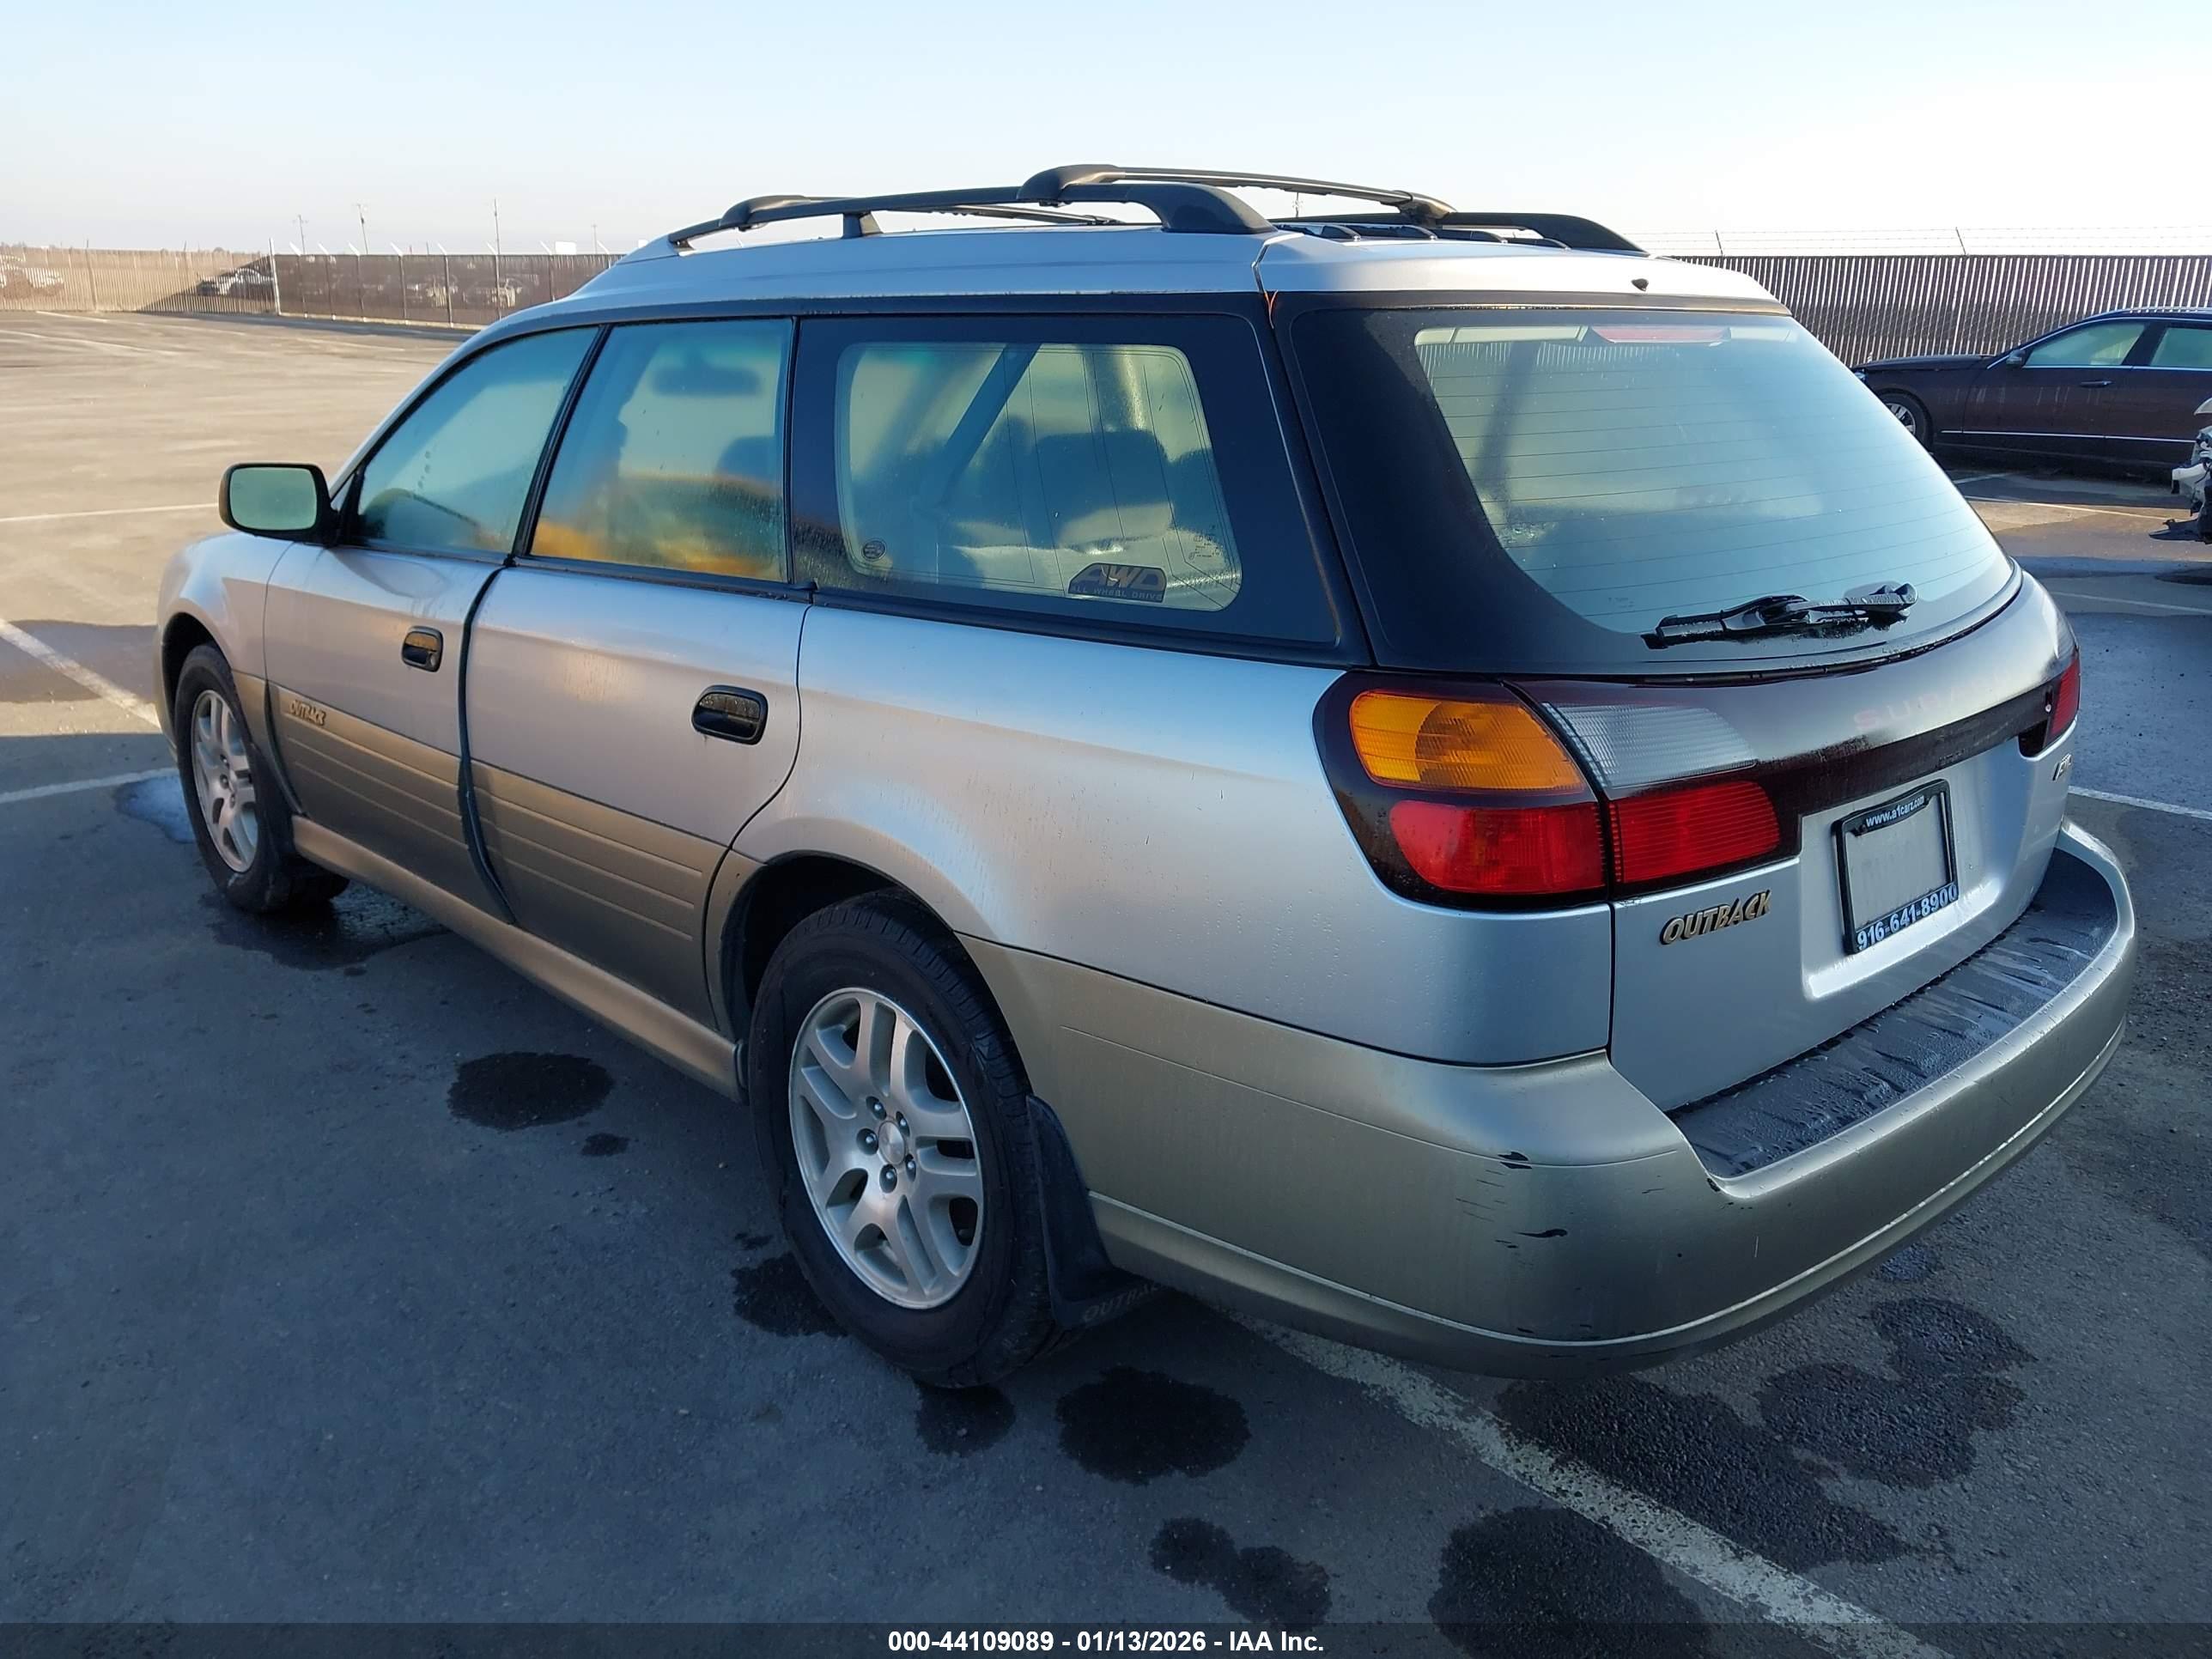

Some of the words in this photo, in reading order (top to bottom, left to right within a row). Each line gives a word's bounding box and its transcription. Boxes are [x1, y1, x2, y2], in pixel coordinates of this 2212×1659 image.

[1865, 795, 1926, 827] www.a1carz.com
[1659, 889, 1771, 945] OUTBACK
[1856, 884, 1958, 951] 916-641-8900
